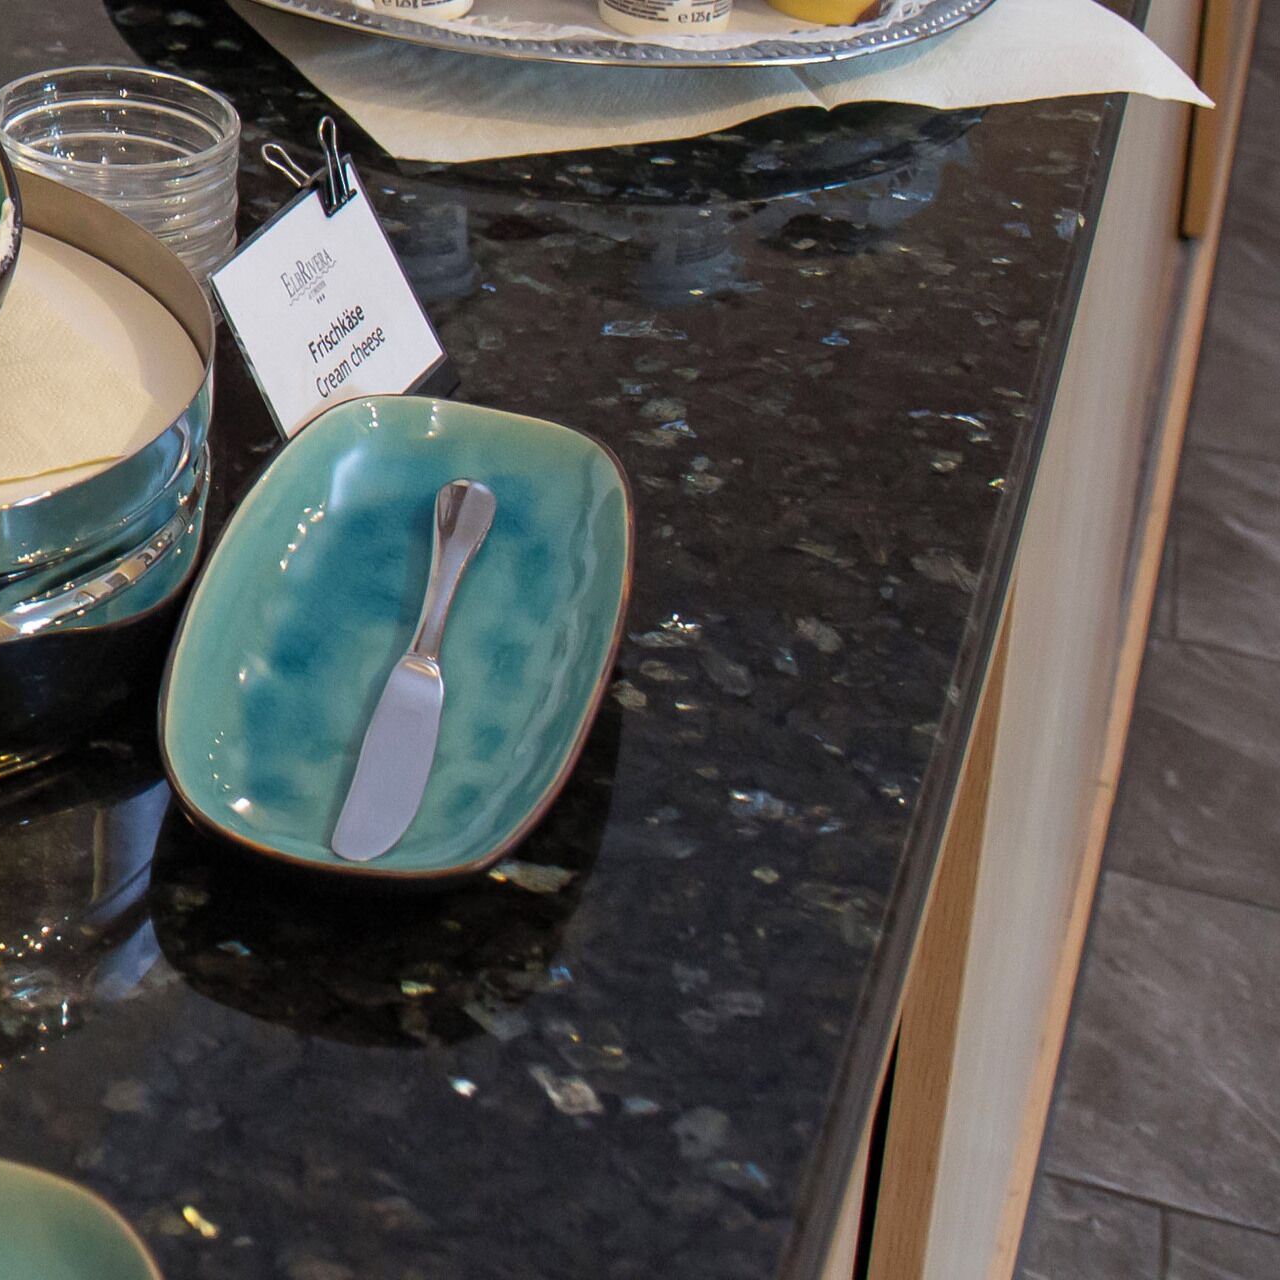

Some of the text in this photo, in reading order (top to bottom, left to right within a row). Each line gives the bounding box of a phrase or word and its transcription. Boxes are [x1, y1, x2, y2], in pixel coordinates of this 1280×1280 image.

[308, 304, 365, 364] Frischkäse
[316, 326, 386, 399] Cream cheese
